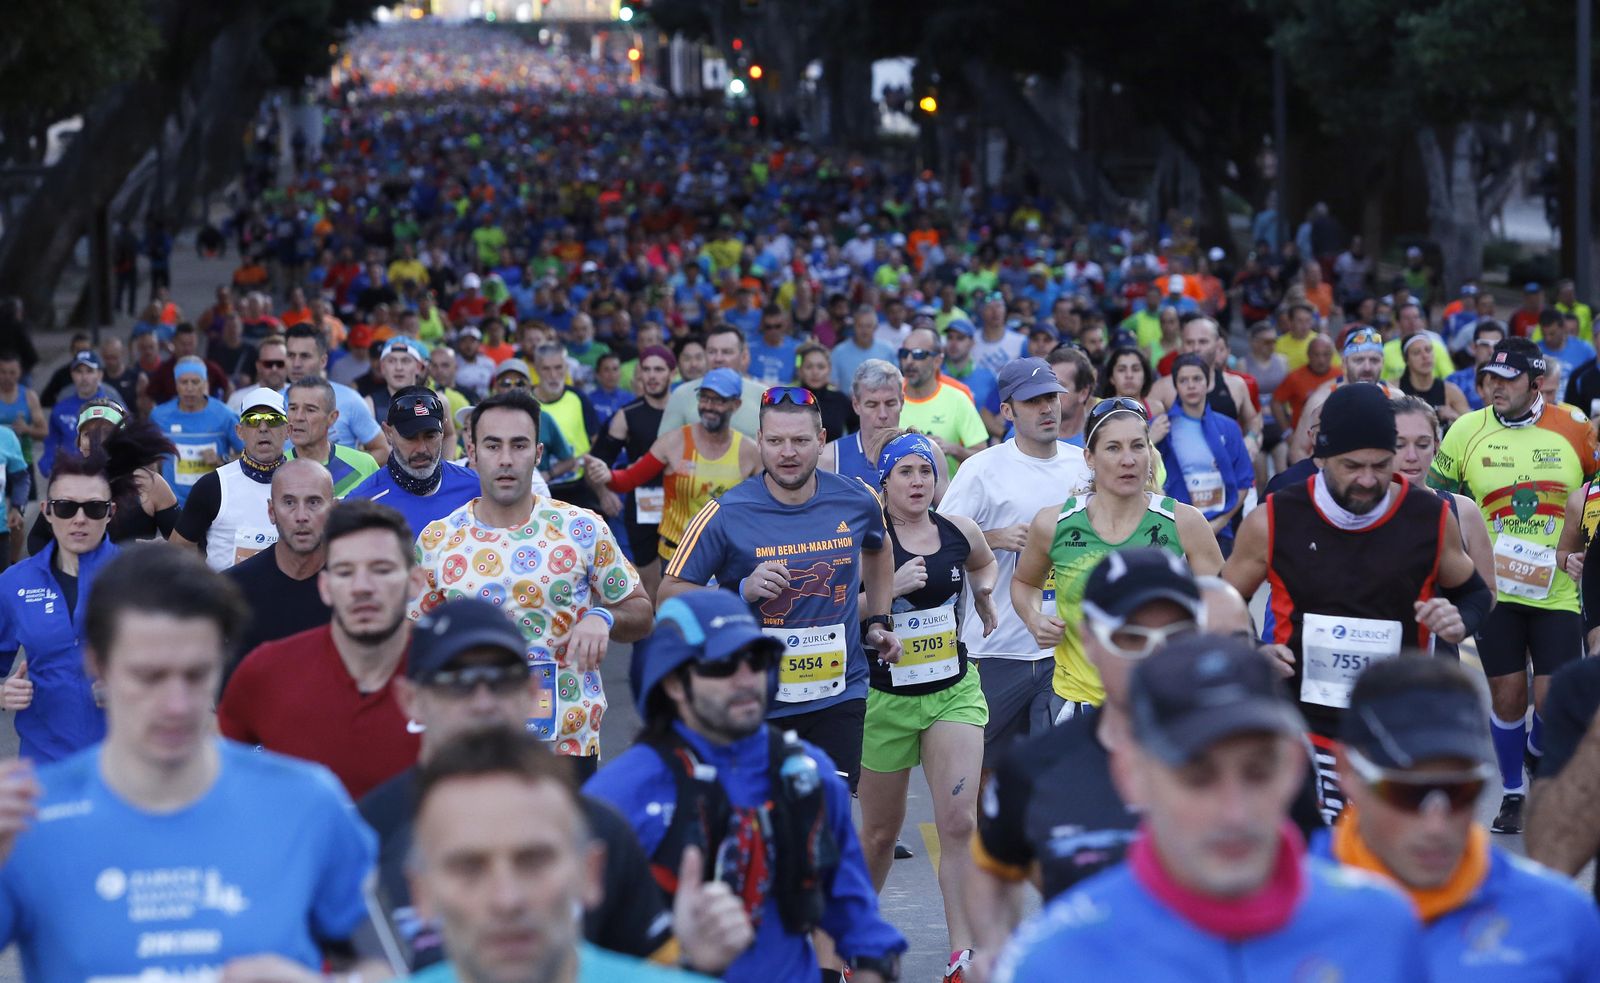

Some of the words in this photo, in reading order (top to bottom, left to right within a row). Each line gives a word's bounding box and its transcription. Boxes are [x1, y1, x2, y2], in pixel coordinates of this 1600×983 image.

[1509, 525, 1538, 535] VERDES
[756, 547, 776, 557] BMW
[778, 537, 853, 555] BERLIN-MARATHON
[1508, 560, 1536, 576] 6297
[922, 614, 948, 625] ZURICH
[1350, 629, 1389, 639] ZURICH
[912, 637, 943, 653] 5703
[789, 657, 823, 671] 5454
[1332, 653, 1370, 670] 7551
